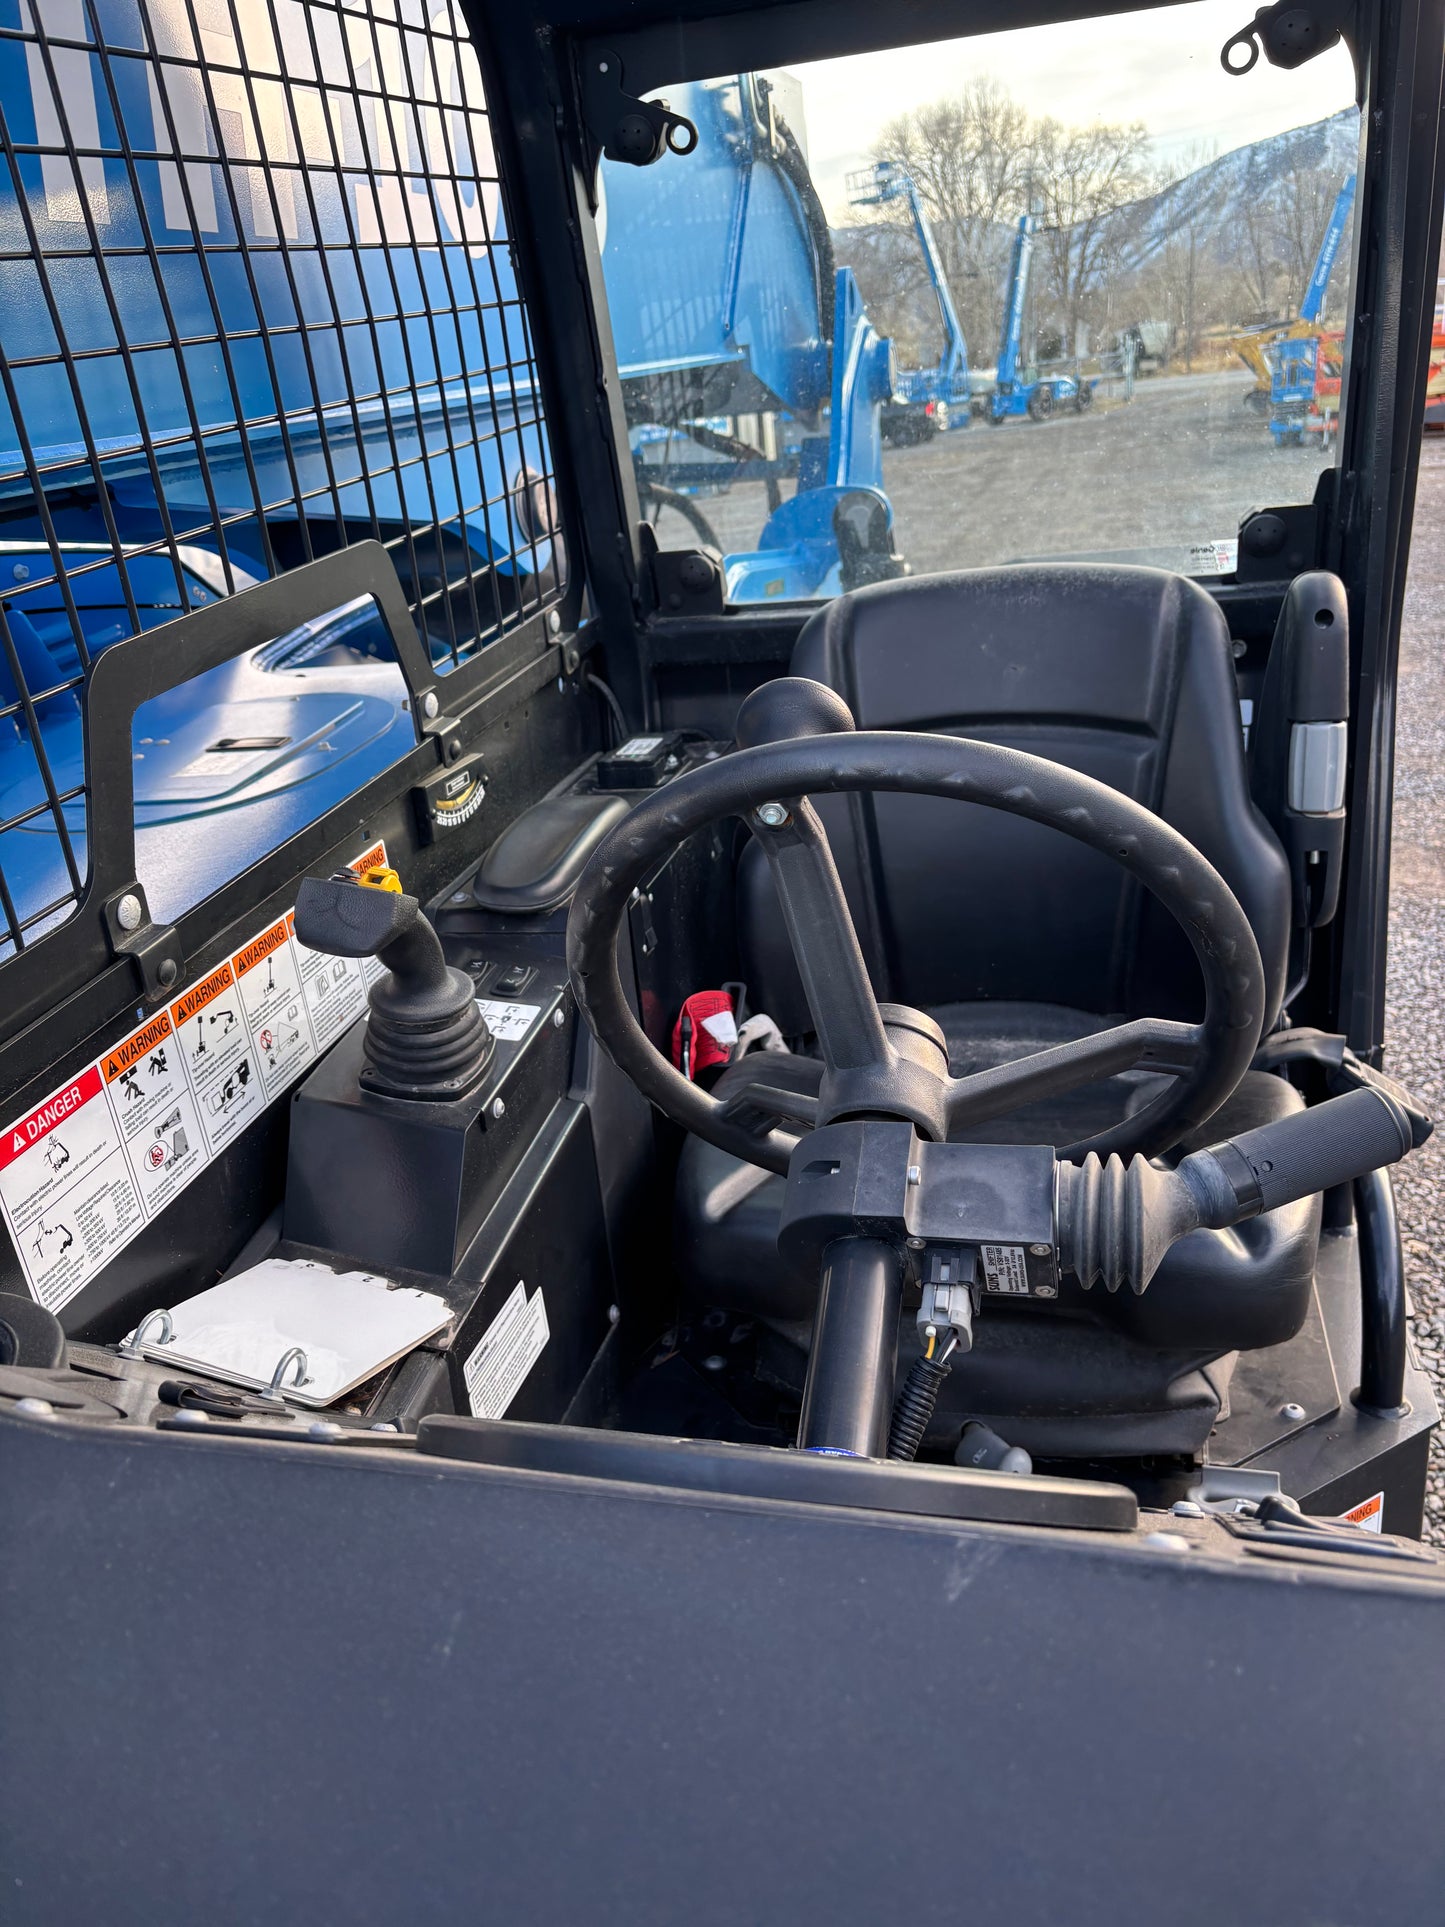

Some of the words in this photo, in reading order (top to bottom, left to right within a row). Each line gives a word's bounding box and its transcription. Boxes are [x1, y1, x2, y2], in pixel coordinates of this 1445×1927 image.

[357, 848, 384, 875] ARNING
[244, 925, 285, 966] WARNING
[185, 968, 231, 1009] WARNING
[117, 1016, 170, 1066] WARNING
[26, 1086, 82, 1140] DANGER
[986, 1247, 996, 1266] SHIFTER
[987, 1273, 1000, 1291] SUNS
